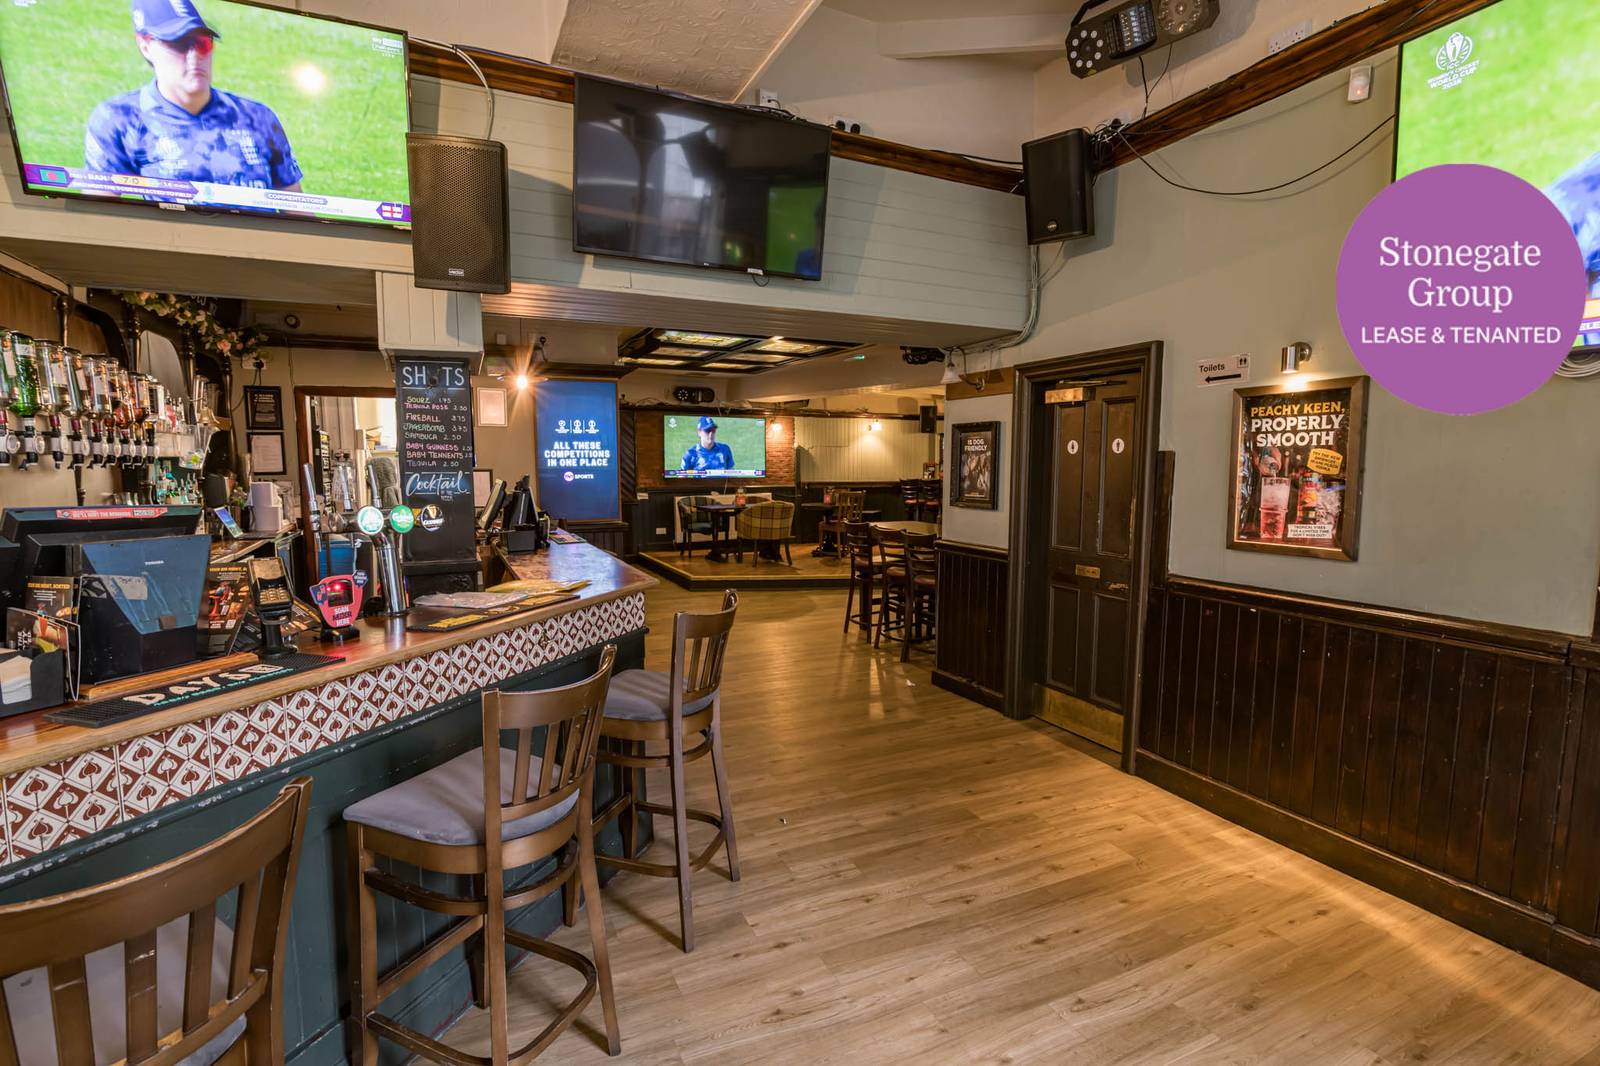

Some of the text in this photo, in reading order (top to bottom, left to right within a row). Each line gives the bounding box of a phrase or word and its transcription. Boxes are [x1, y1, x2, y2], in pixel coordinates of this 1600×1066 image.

[1429, 66, 1478, 88] WORLD CUP
[1199, 363, 1225, 373] Toilets
[402, 365, 465, 387] SHTS
[406, 396, 431, 404] SOURZ
[1250, 401, 1346, 417] PEACHY KEEN,
[405, 412, 441, 423] FIREBALL
[1250, 414, 1345, 433] PROPERLY
[404, 432, 438, 440] SAMBUCA
[1256, 431, 1335, 448] SMOOTH
[405, 442, 424, 450] BABY
[426, 443, 459, 451] GUINNESS
[553, 441, 601, 450] ALL THESE
[964, 444, 988, 452] FRIENDLY
[406, 451, 426, 459] BABY
[544, 450, 611, 458] COMPETITIONS
[547, 458, 609, 467] IN ONE PLACE
[405, 470, 468, 497] Cocktail
